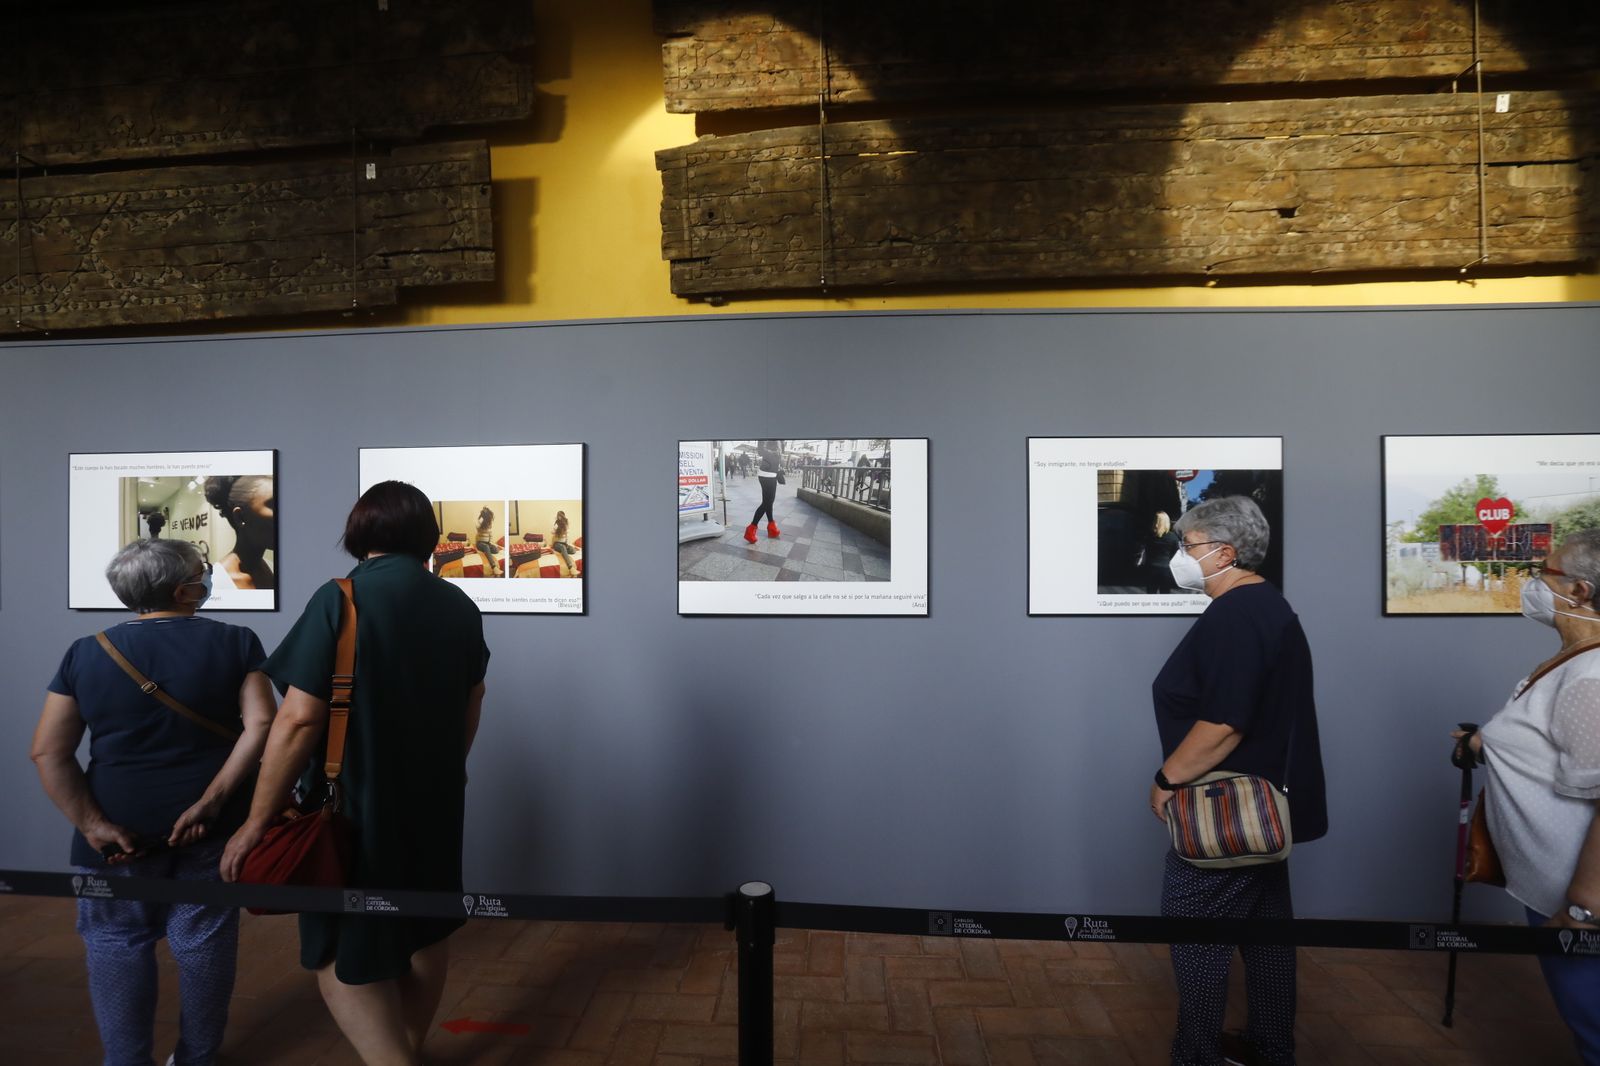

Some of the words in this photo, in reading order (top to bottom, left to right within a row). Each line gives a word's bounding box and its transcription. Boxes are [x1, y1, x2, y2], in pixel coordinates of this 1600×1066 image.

[1479, 508, 1510, 520] CLUB
[180, 512, 208, 531] VENDE
[793, 593, 807, 601] salgo
[87, 876, 107, 887] Ruta
[479, 895, 502, 907] Ruta
[1083, 916, 1108, 929] Ruta
[1580, 930, 1600, 943] Rut
